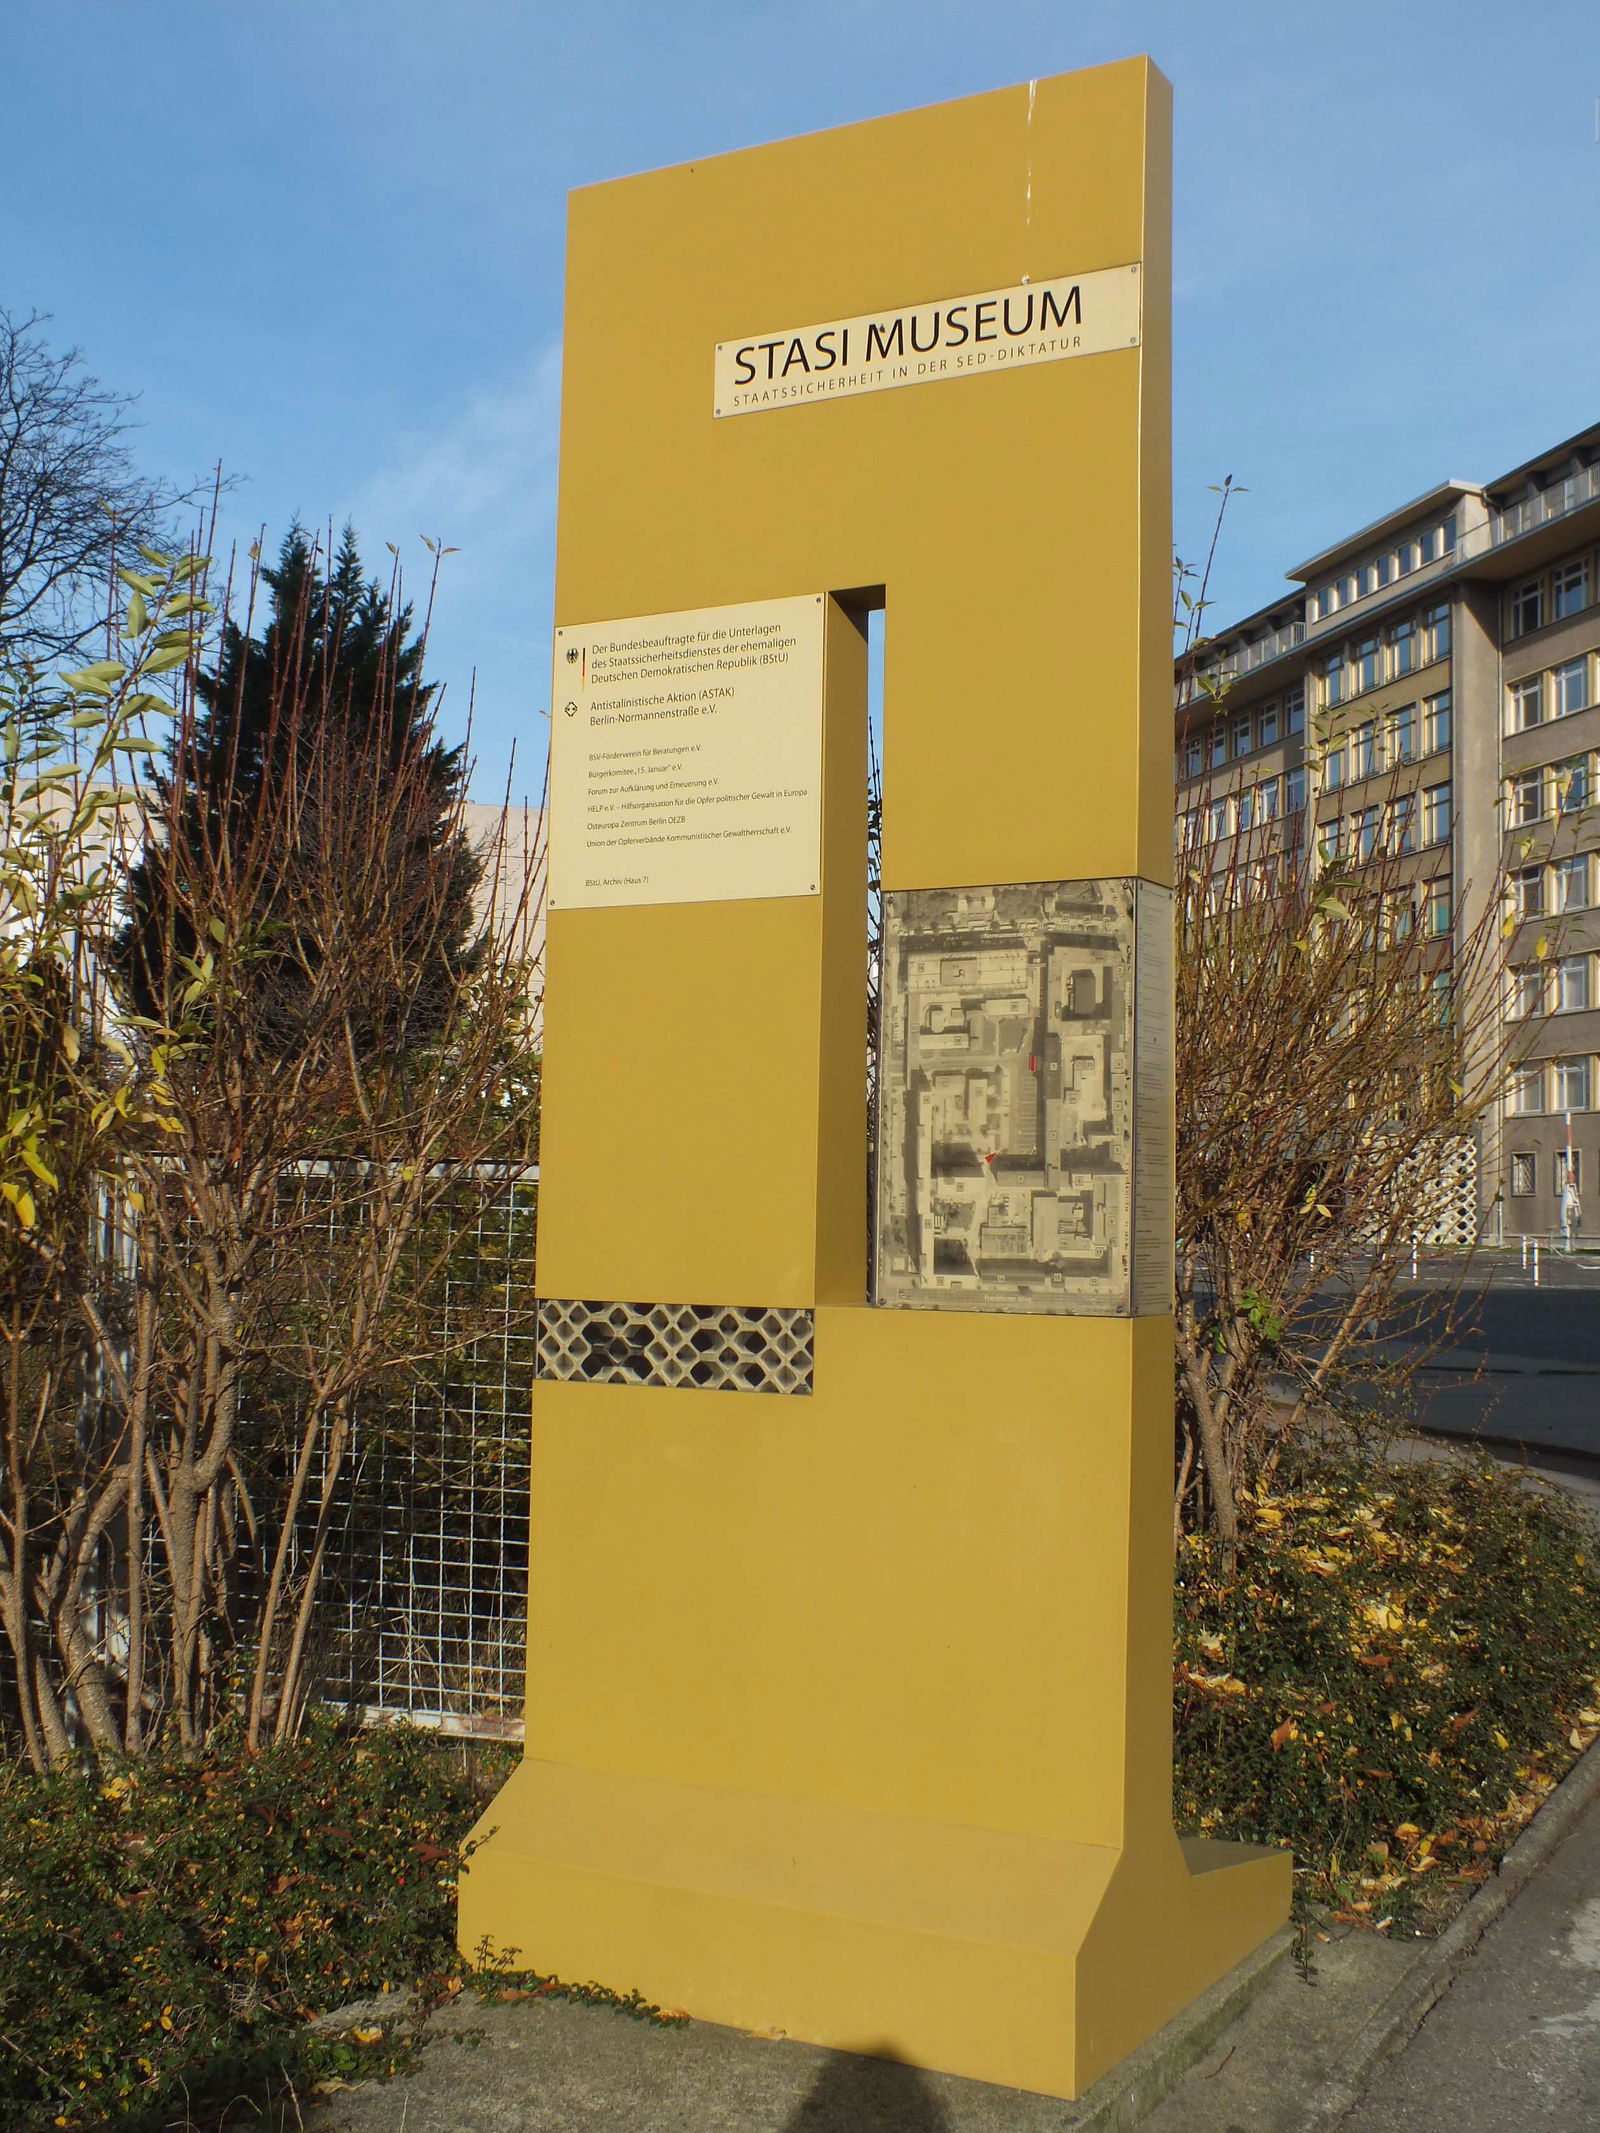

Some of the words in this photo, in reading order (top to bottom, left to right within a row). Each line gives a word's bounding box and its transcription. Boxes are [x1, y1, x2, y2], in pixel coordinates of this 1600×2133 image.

[735, 329, 848, 385] STASI
[866, 285, 1081, 362] MUSEUM
[734, 370, 883, 407] STAATSSICHERHEIT
[893, 366, 907, 379] IN
[918, 360, 946, 374] DER
[957, 336, 1080, 368] SED-DIKTATUR
[592, 645, 607, 654] Der
[610, 635, 695, 652] Bundesbeauftragte
[697, 632, 711, 642] für
[712, 630, 727, 641] die
[729, 625, 781, 638] Unterlagen
[592, 659, 607, 669] des
[609, 647, 720, 667] Staatssicherheitsdienstes
[723, 644, 738, 654] der
[741, 638, 796, 652] ehemaligen
[592, 671, 638, 684] Deutschen
[641, 662, 714, 678] Demokratischen
[717, 656, 757, 670] Republik
[760, 652, 788, 666] (BStU)
[590, 695, 664, 711] Antistalinistische
[667, 692, 698, 703] Aktion
[699, 686, 734, 700] (ASTAK)
[590, 706, 699, 726] Berlin-Normannenstraße
[702, 704, 717, 714] e.V.
[643, 748, 652, 756] für
[653, 747, 689, 756] Beratungen
[691, 744, 702, 752] e.V.
[588, 788, 608, 796] Forum
[620, 783, 654, 793] Aufklärung
[656, 782, 668, 790] und
[670, 780, 707, 790] Erneuerung
[708, 778, 719, 786] e.V.
[587, 804, 603, 812] HELP
[621, 800, 673, 811] Hilfsorganisation
[675, 798, 684, 806] für
[685, 797, 696, 805] die
[697, 796, 715, 806] Opfer
[716, 792, 750, 803] politischer
[752, 791, 775, 800] Gewalt
[776, 790, 783, 798] in
[784, 789, 807, 797] Europa
[587, 822, 619, 831] Osteuropa
[649, 818, 667, 826] Berlin
[586, 840, 605, 848] Union
[606, 839, 617, 847] der
[666, 832, 722, 842] Kommunistischer
[723, 826, 779, 839] Gewaltherrschaft
[780, 825, 792, 834] e.V.
[624, 877, 641, 885] (Haus
[643, 876, 649, 884] 7)
